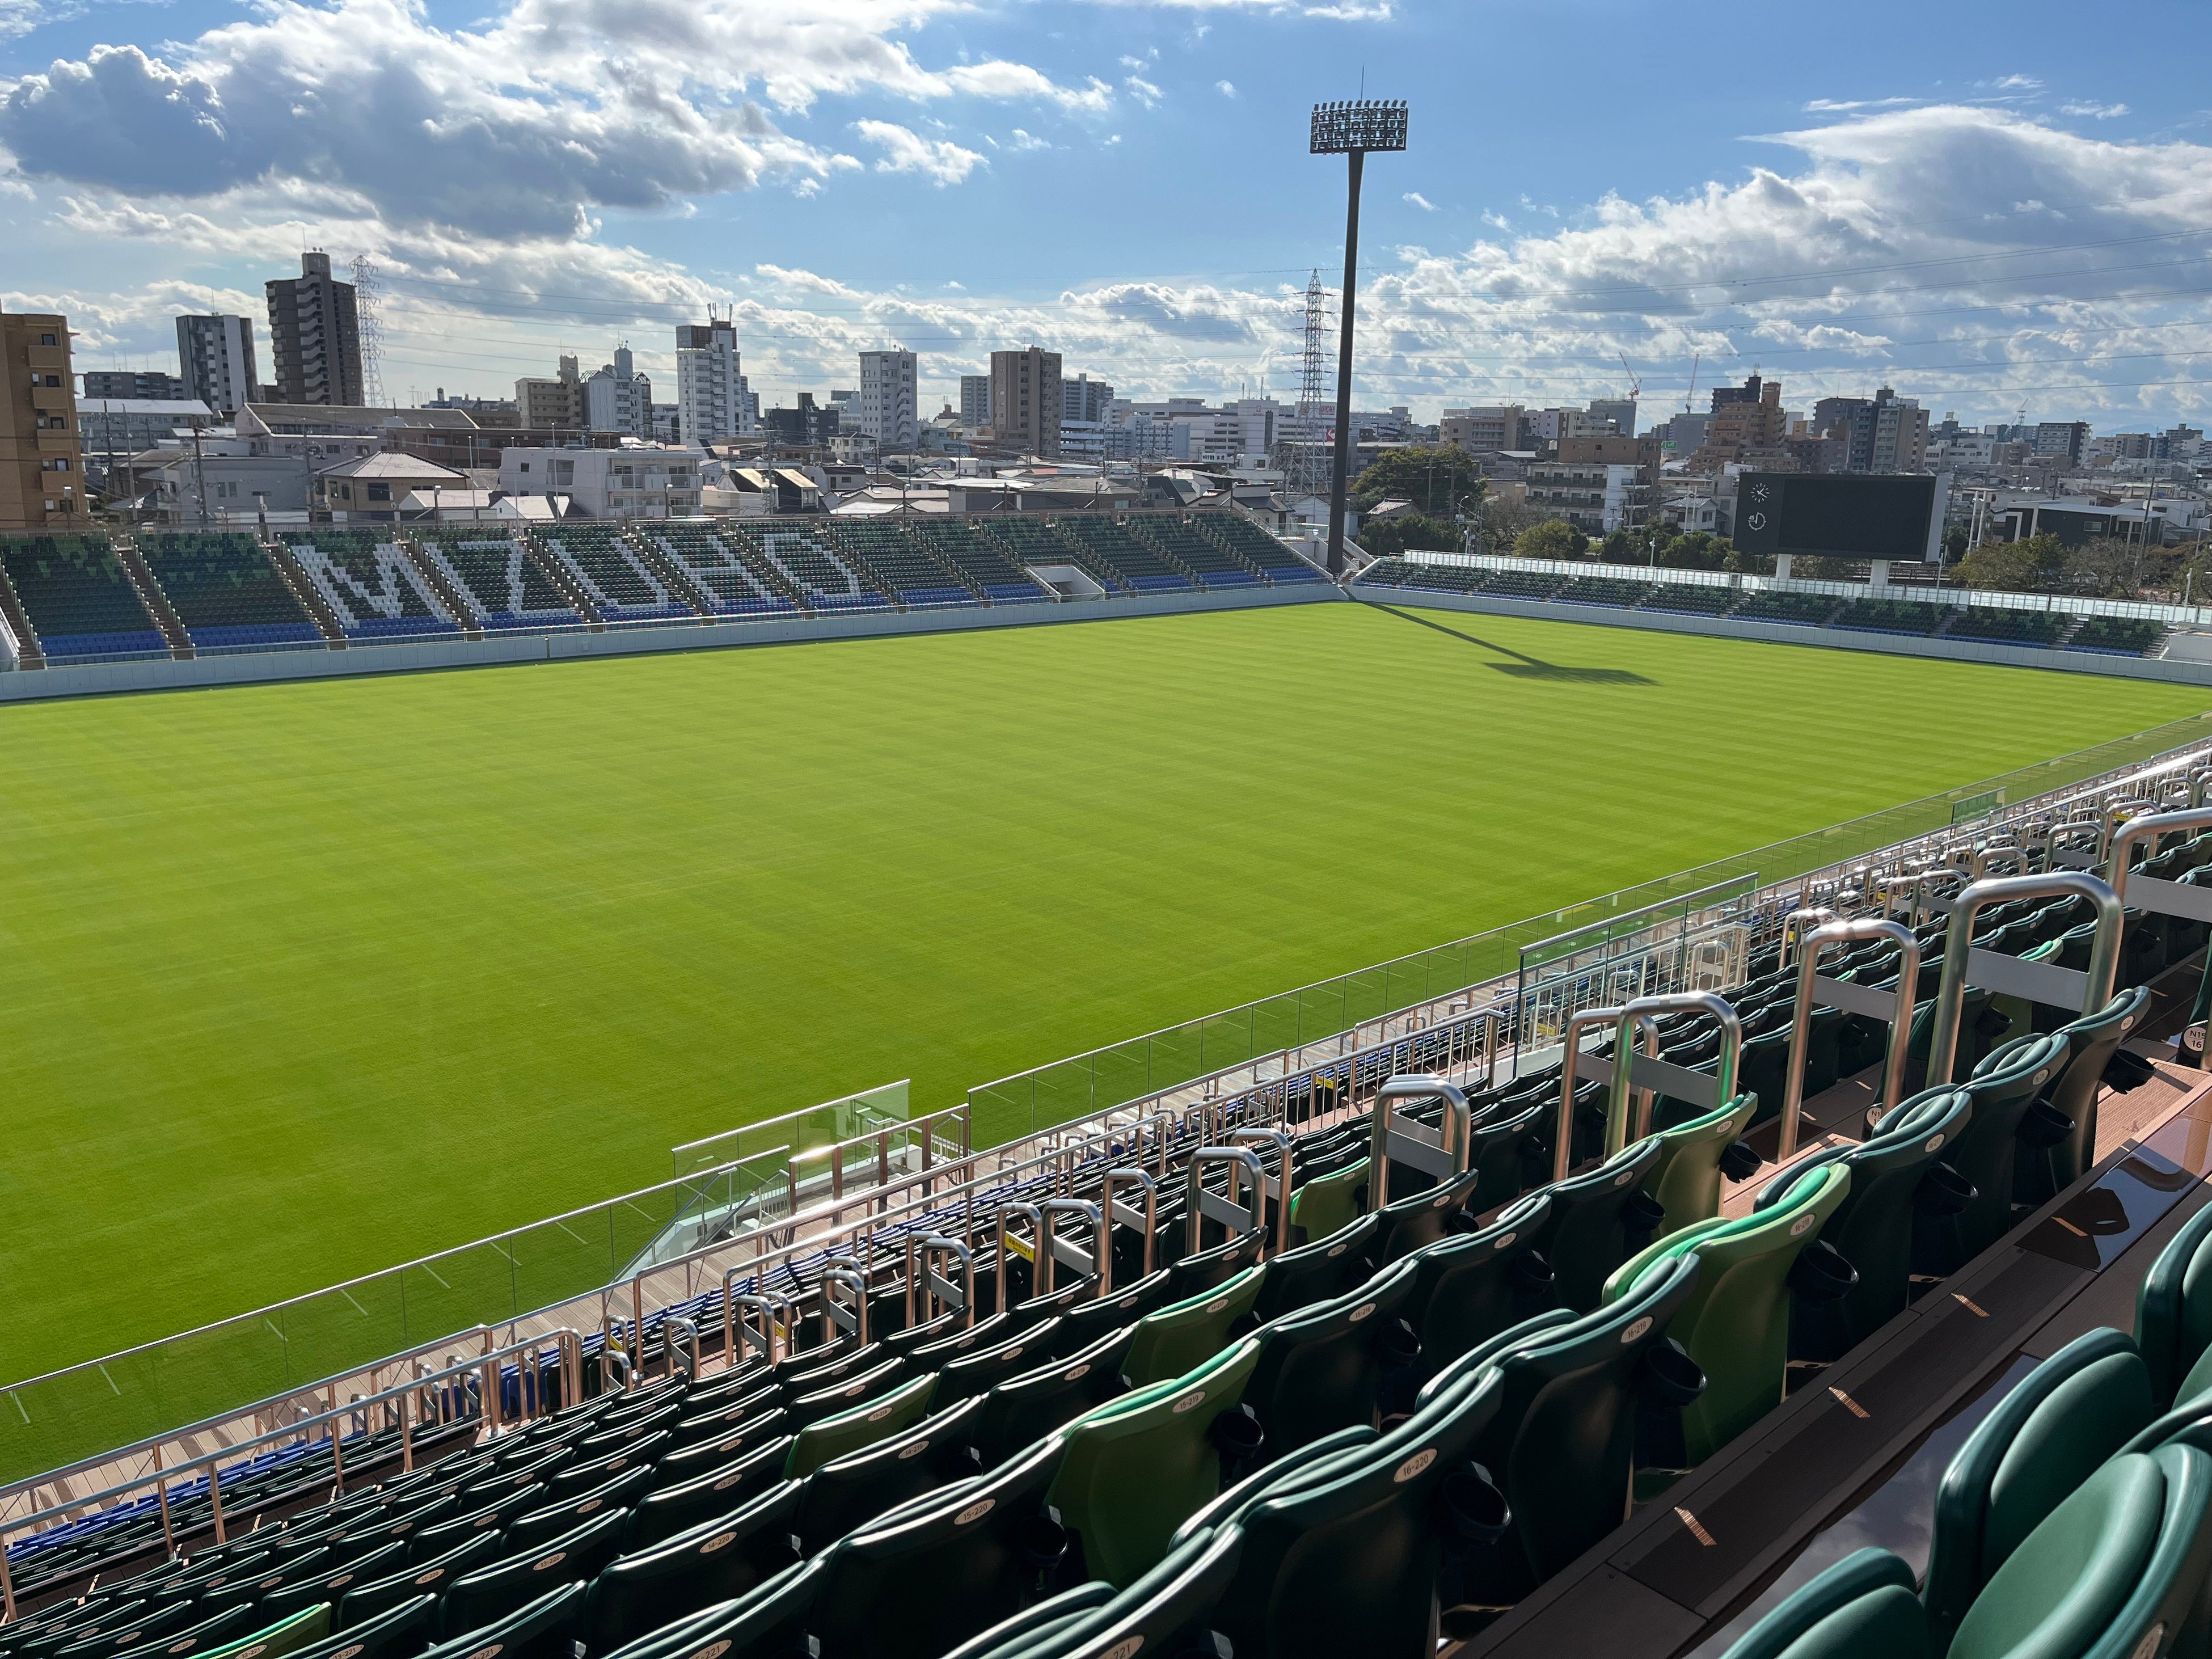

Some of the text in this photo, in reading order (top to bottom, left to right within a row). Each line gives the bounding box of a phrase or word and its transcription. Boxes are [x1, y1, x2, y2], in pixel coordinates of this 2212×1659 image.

[290, 532, 862, 629] MIZUHO
[2189, 1030, 2206, 1039] N15
[1795, 1218, 1809, 1232] 16-218
[1499, 1235, 1512, 1246] 15-217
[1211, 1301, 1224, 1311] 14-217
[1354, 1306, 1371, 1318] 15-218
[1627, 1322, 1646, 1339] 16-219
[1070, 1367, 1085, 1378] 14-218
[1179, 1395, 1199, 1409] 15-219
[905, 1443, 923, 1456] 14-219
[1403, 1454, 1428, 1476] 16-220
[720, 1477, 736, 1487] 13-219
[582, 1502, 597, 1511] 12-219
[963, 1504, 987, 1521] 15-220
[707, 1535, 729, 1550] 14-220
[540, 1556, 559, 1567] 13-220
[421, 1571, 439, 1582] 12-220
[174, 1641, 191, 1650] 11-221
[1113, 1643, 1130, 1659] 221
[242, 1647, 261, 1658] 12-221
[334, 1648, 356, 1659] 13-221
[474, 1648, 493, 1659] -221
[695, 1645, 720, 1659] -221
